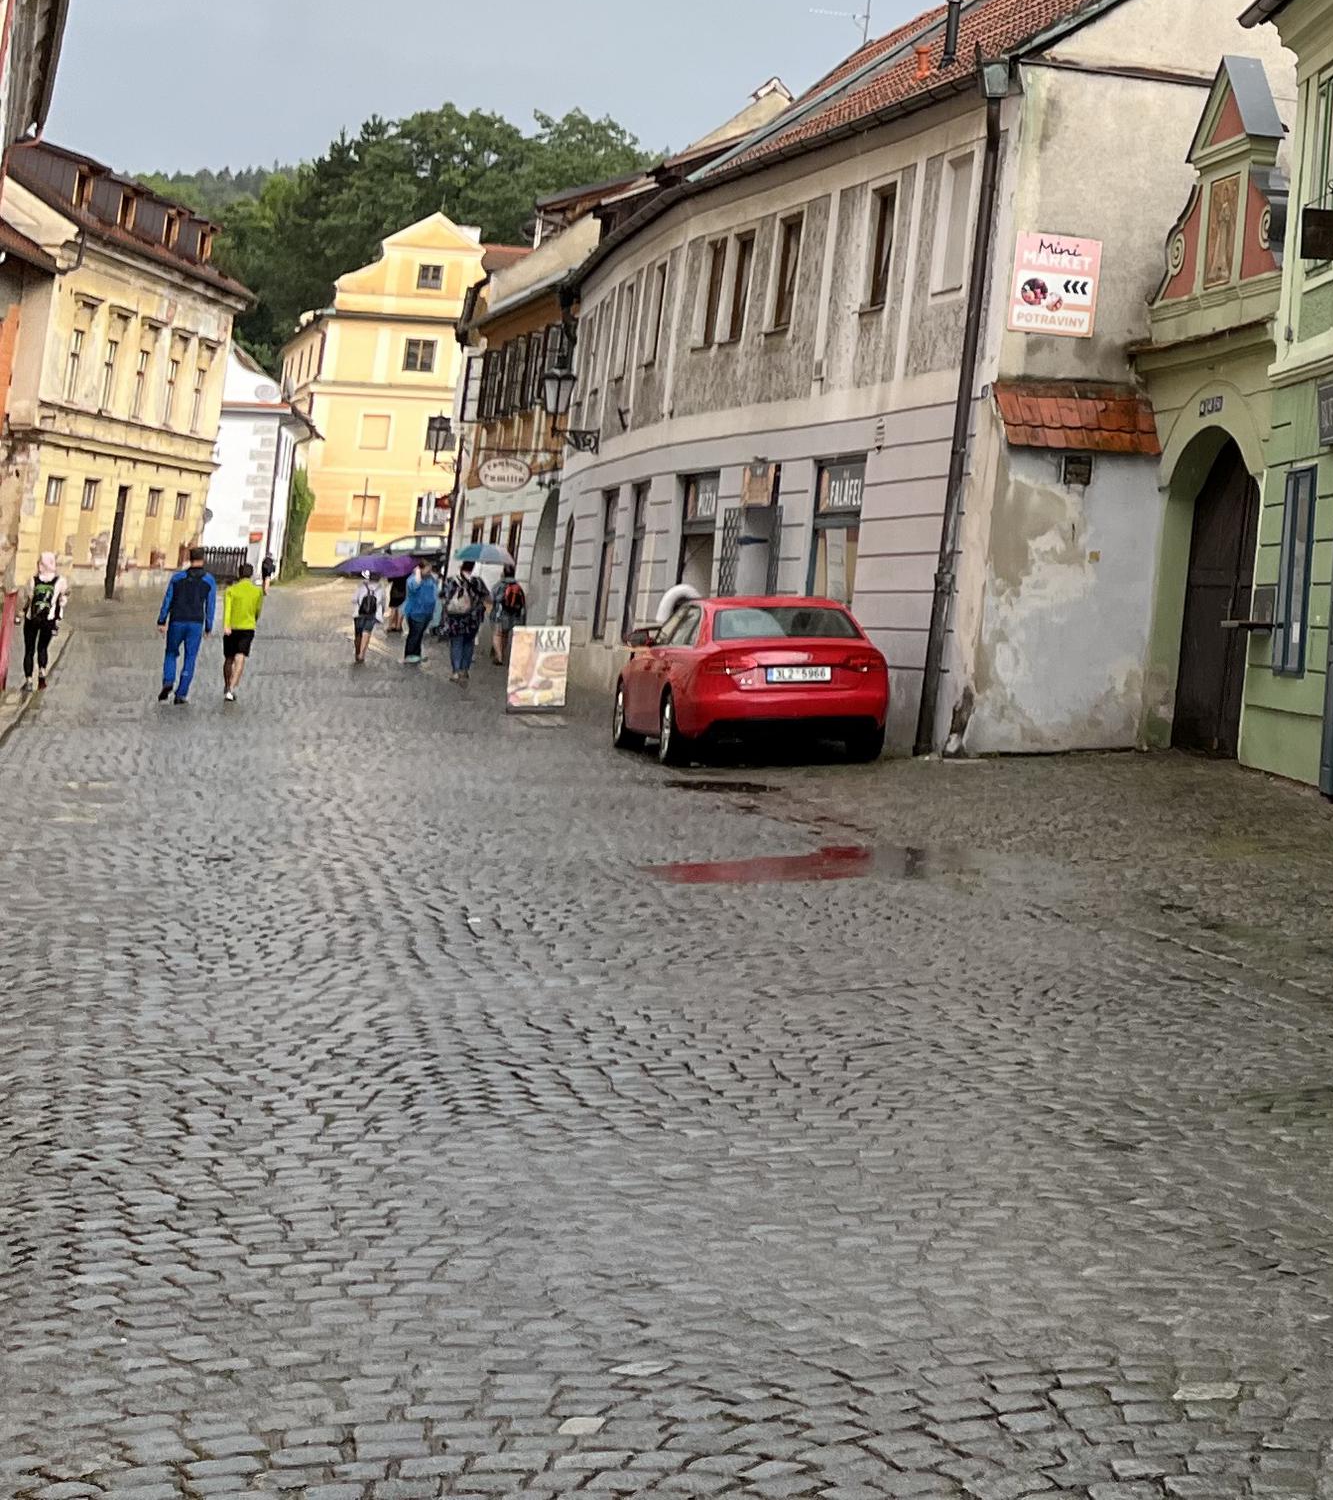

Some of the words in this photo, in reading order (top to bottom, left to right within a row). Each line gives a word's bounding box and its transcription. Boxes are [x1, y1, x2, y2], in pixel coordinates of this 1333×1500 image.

[1038, 238, 1082, 257] Mini
[1022, 250, 1093, 272] MARKET
[1016, 311, 1086, 329] POTRAVINY
[829, 478, 863, 508] FALAFEL
[534, 630, 567, 653] K&K
